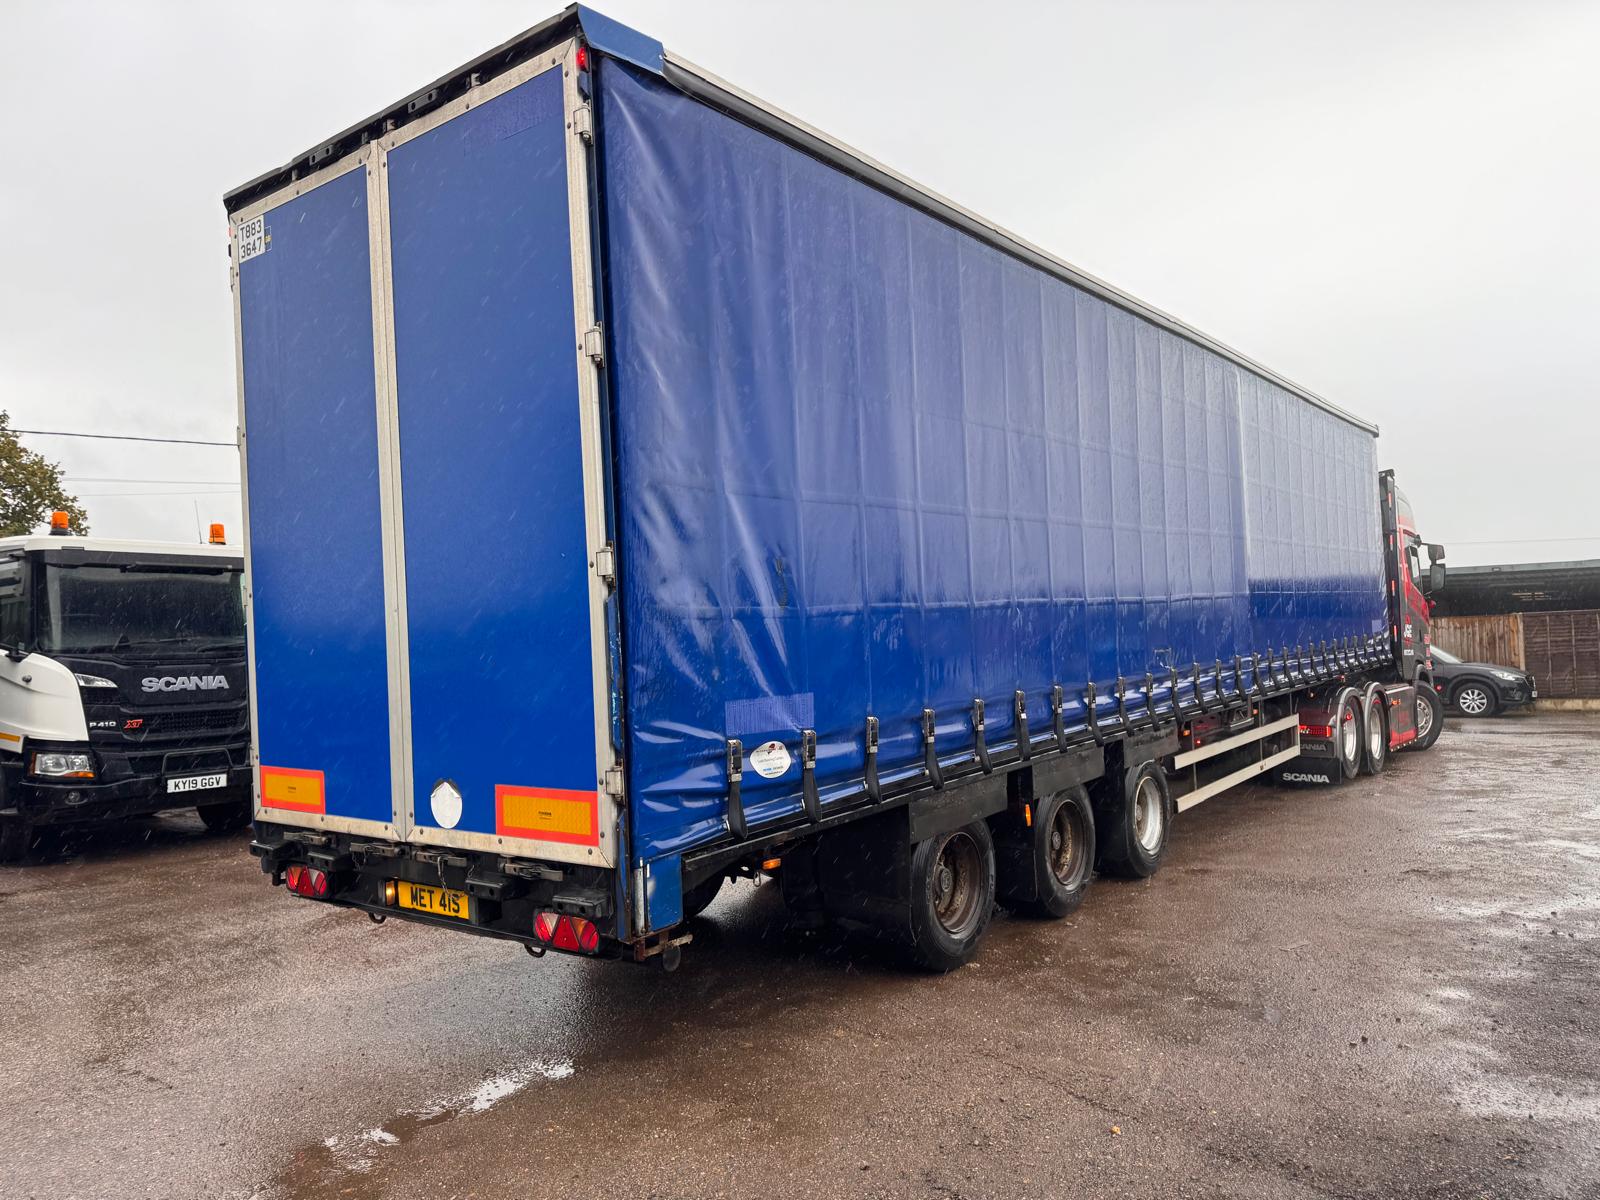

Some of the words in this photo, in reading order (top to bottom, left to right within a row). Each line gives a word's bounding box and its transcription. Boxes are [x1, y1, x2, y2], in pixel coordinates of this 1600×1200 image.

[240, 219, 262, 242] T883
[241, 236, 262, 258] 3647
[141, 675, 230, 693] SCANIA
[173, 779, 198, 791] KY19
[200, 776, 222, 787] GGV
[1282, 772, 1330, 784] SCANIA
[410, 886, 435, 909] MET
